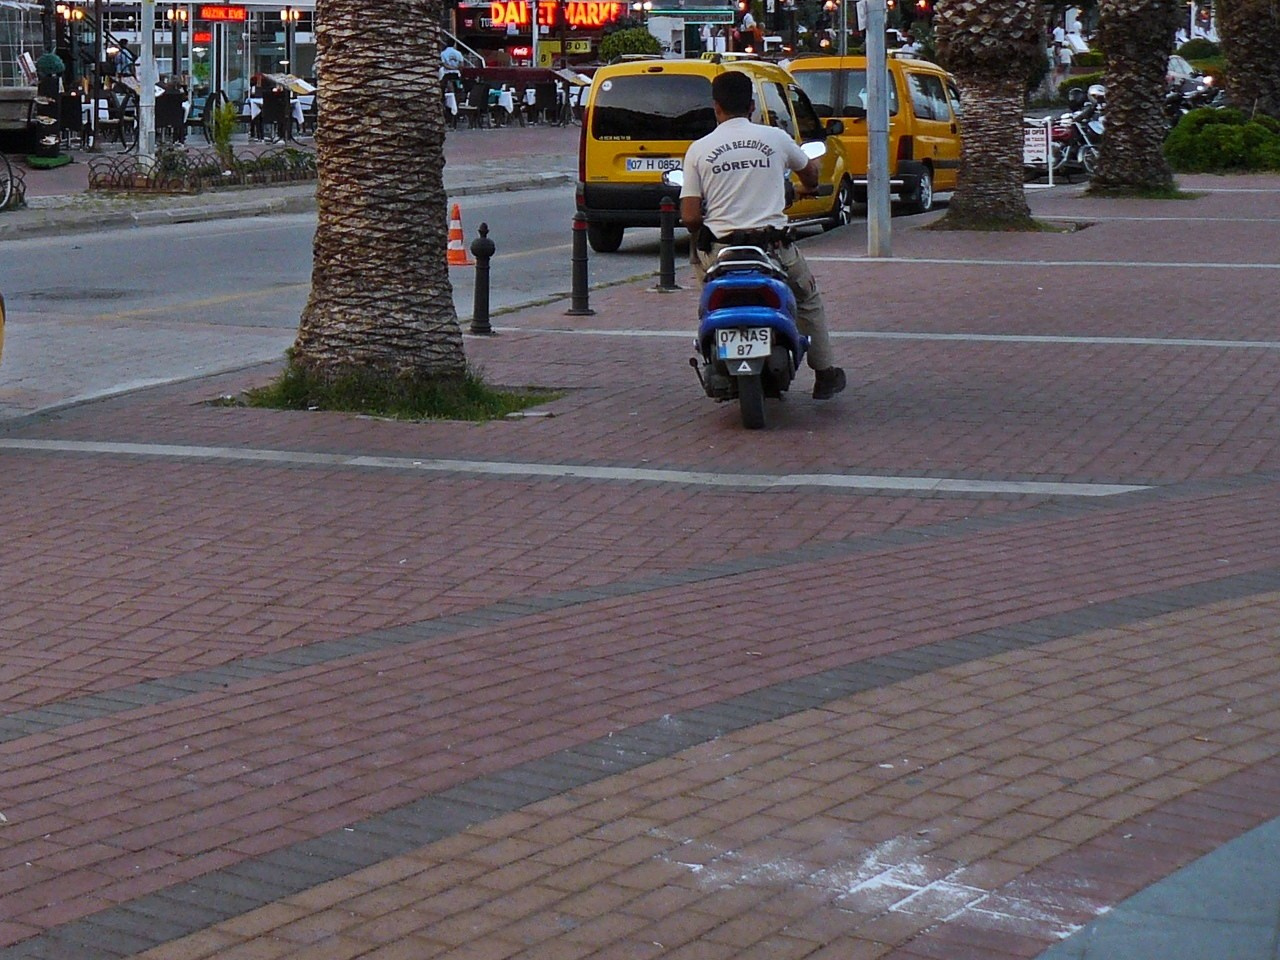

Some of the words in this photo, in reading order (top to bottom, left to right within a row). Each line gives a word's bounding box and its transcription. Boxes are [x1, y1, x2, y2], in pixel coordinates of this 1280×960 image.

[706, 144, 732, 163] ALANYA
[630, 160, 642, 170] 07
[646, 160, 654, 170] H
[657, 160, 681, 170] 0852
[721, 331, 738, 343] 07
[740, 330, 769, 342] NAS
[737, 345, 753, 356] 87
